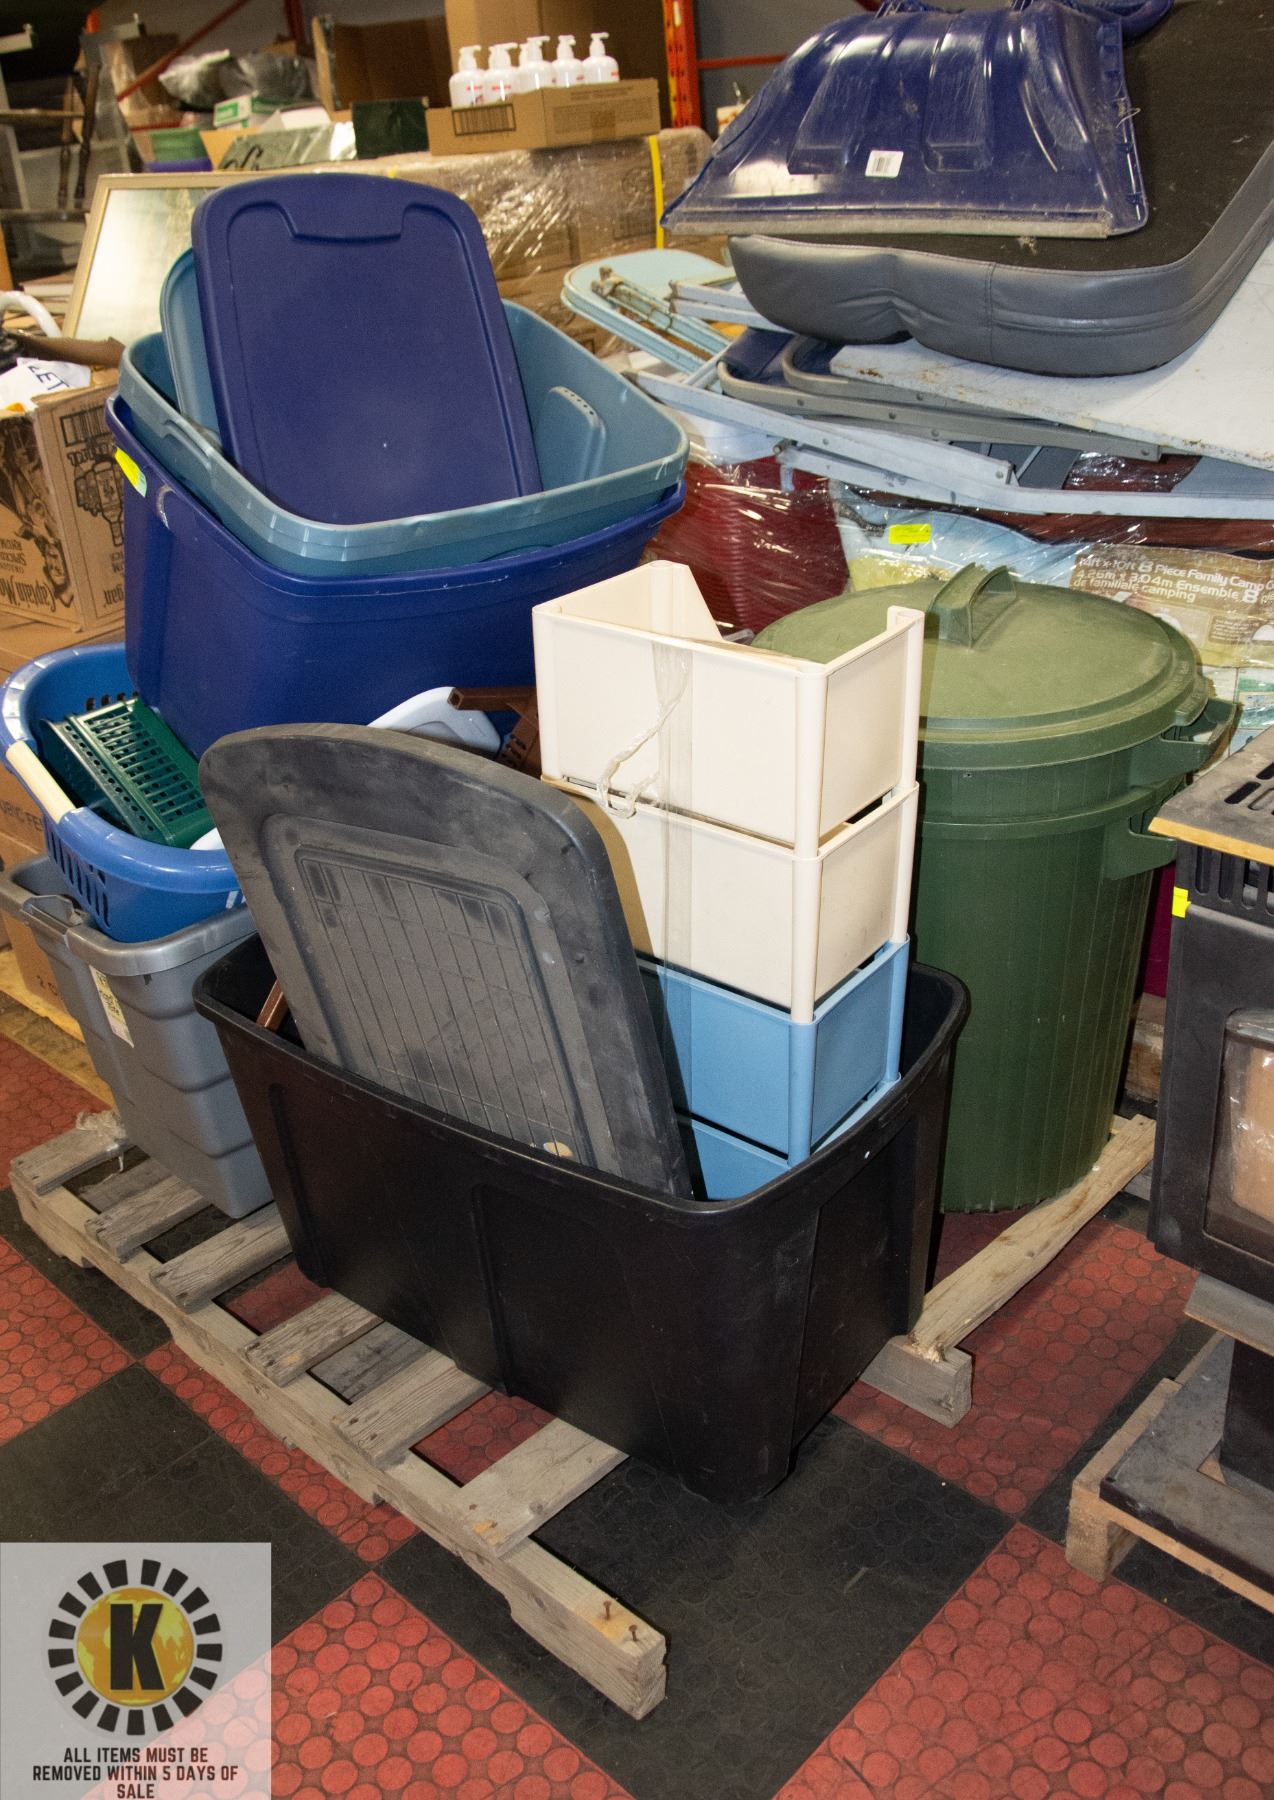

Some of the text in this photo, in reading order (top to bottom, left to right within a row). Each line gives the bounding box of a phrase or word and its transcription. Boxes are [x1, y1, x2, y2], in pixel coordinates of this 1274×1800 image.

[1138, 560, 1154, 573] 8
[1154, 563, 1187, 577] Piece
[1187, 568, 1229, 587] Family
[1140, 584, 1197, 603] camping
[1175, 579, 1240, 600] Ensemble
[1242, 588, 1260, 604] 8
